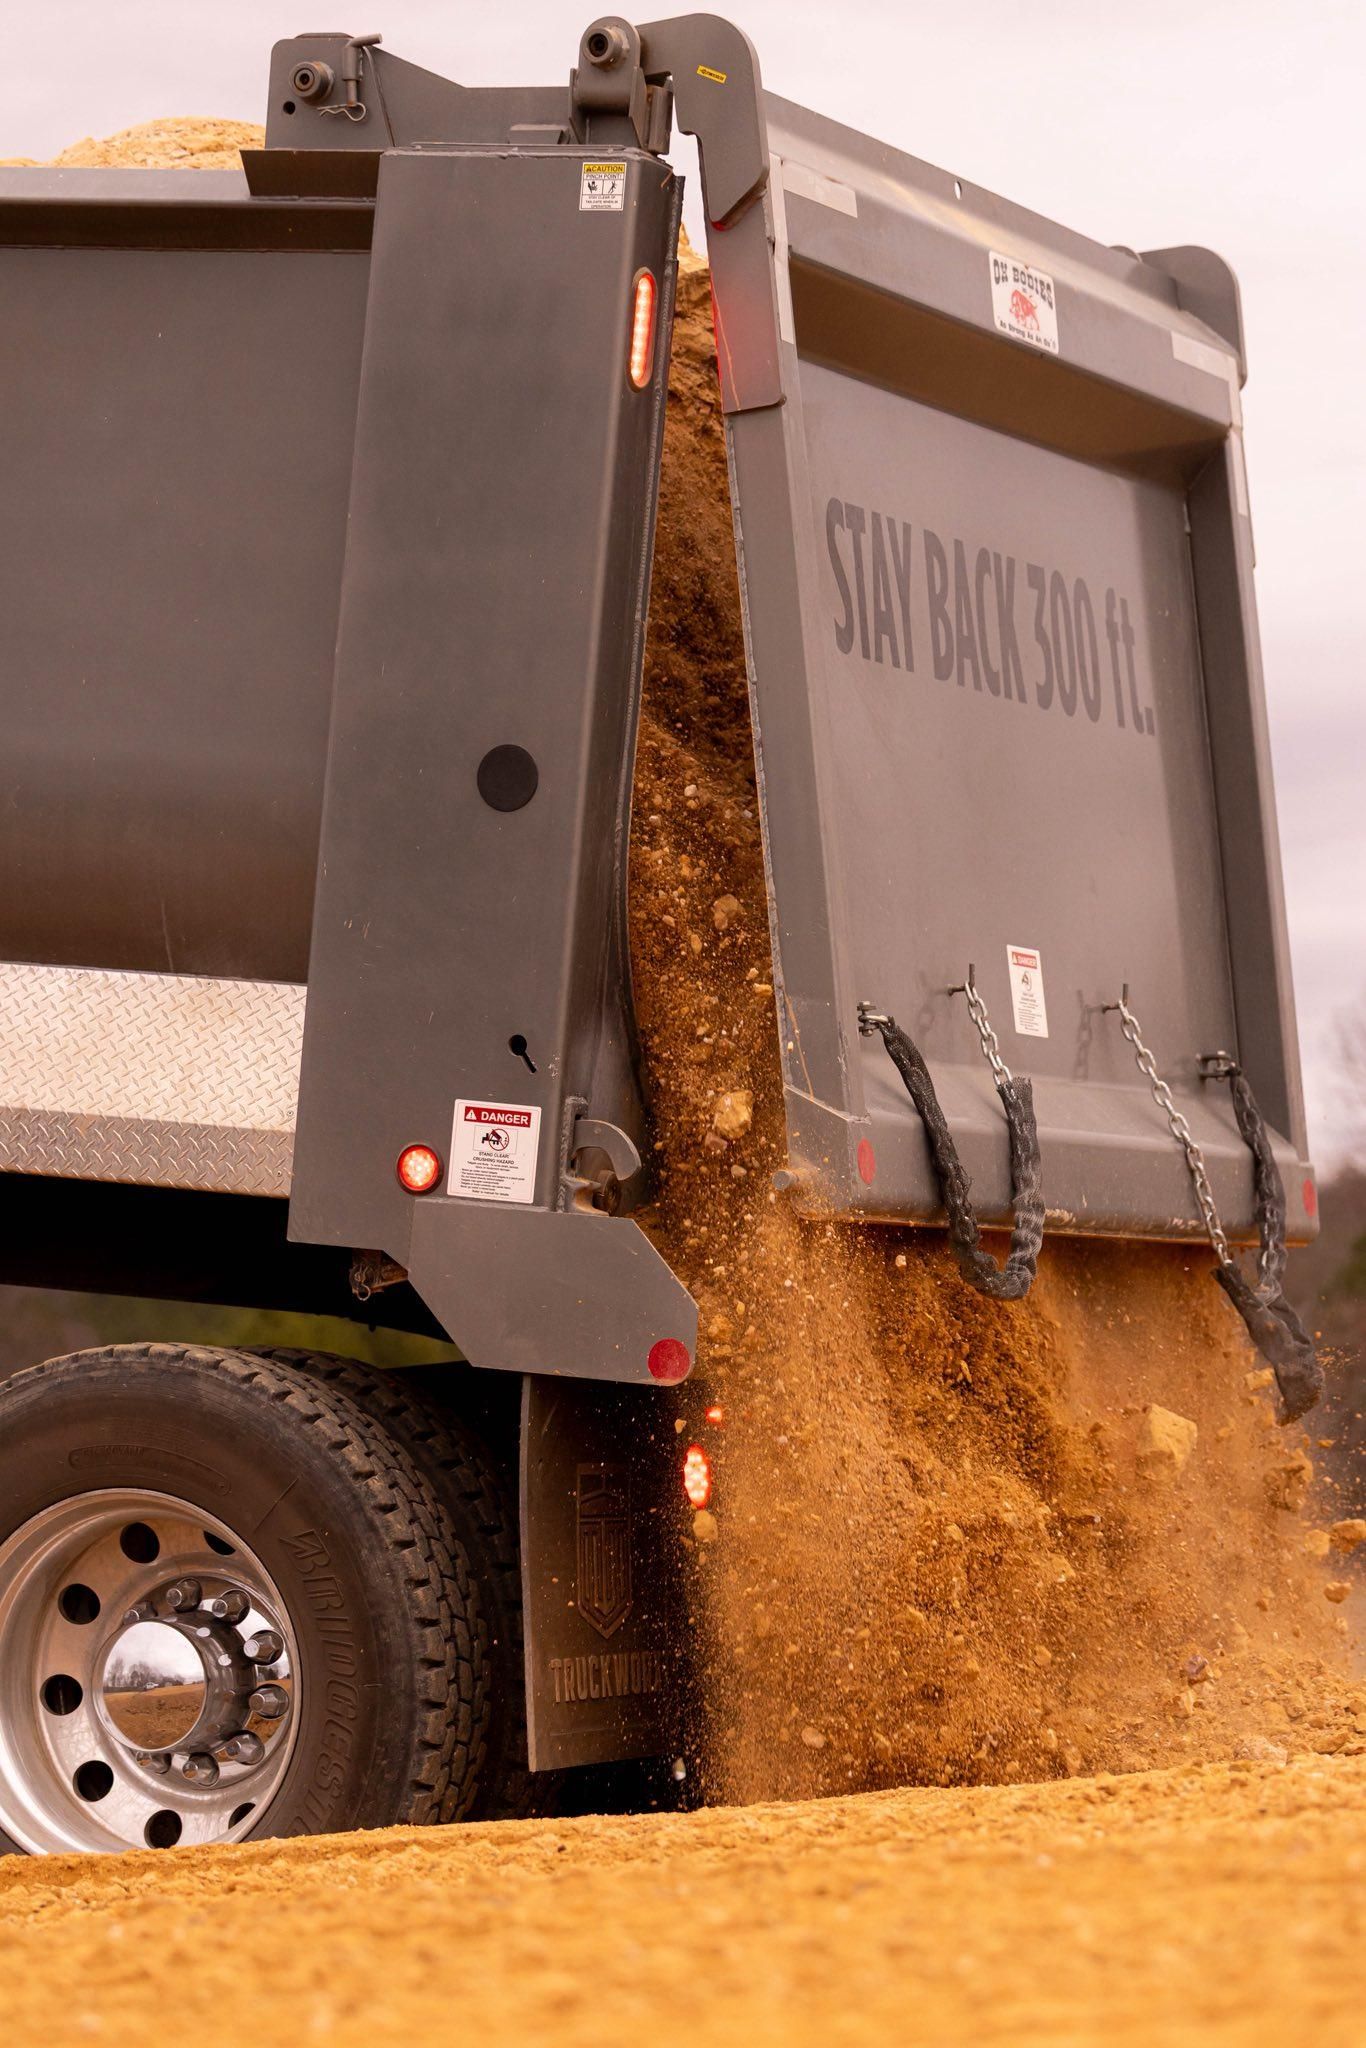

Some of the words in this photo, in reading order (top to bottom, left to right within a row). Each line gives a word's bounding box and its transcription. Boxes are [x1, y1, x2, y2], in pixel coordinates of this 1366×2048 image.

[993, 259, 1008, 285] OX
[1012, 266, 1054, 310] BODIES
[826, 497, 915, 673] STAY
[923, 528, 1028, 704] BACK
[1026, 562, 1102, 723] 300
[1105, 587, 1155, 736] ft.
[481, 1111, 529, 1125] DANGER
